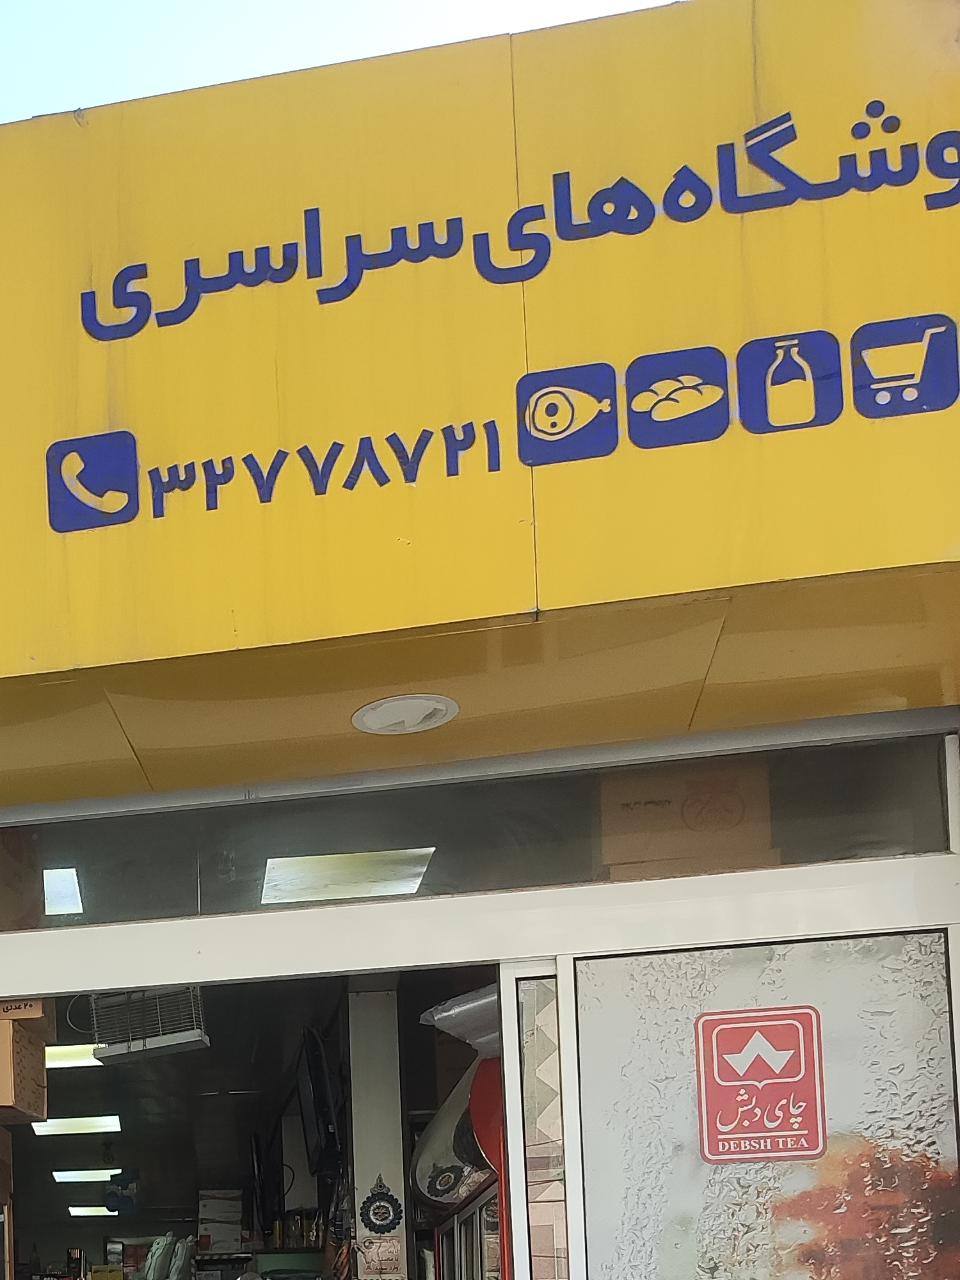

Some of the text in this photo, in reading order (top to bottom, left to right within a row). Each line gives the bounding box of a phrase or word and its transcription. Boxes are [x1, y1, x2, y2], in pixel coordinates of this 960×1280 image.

[80, 208, 464, 342] سراسری
[716, 1088, 807, 1132] چای دبش
[718, 1137, 808, 1152] DEBSH TEA
